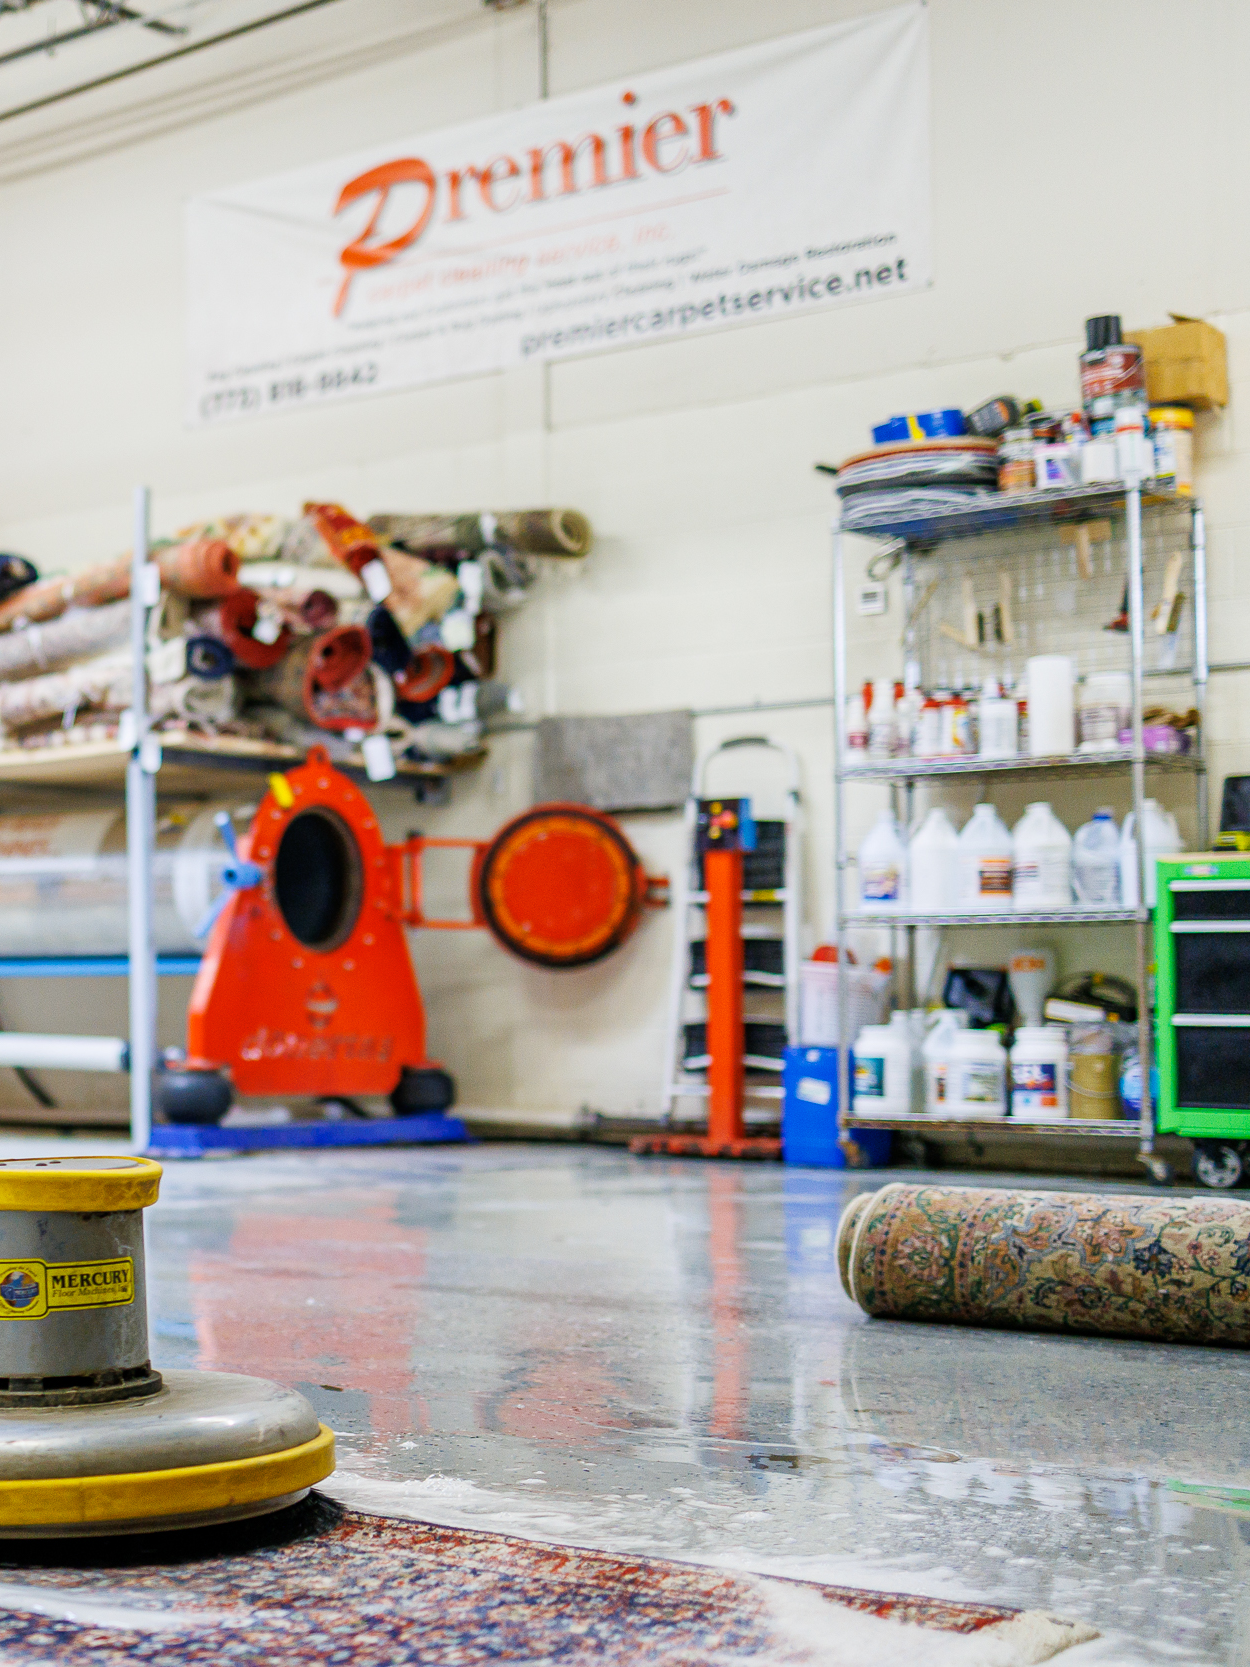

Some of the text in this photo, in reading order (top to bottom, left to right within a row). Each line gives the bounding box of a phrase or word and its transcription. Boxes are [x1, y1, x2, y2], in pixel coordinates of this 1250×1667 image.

[332, 90, 735, 318] Premier
[521, 257, 910, 356] premiercarpetservice.net
[51, 1269, 129, 1289] MERCURY
[52, 1289, 76, 1298] Floor
